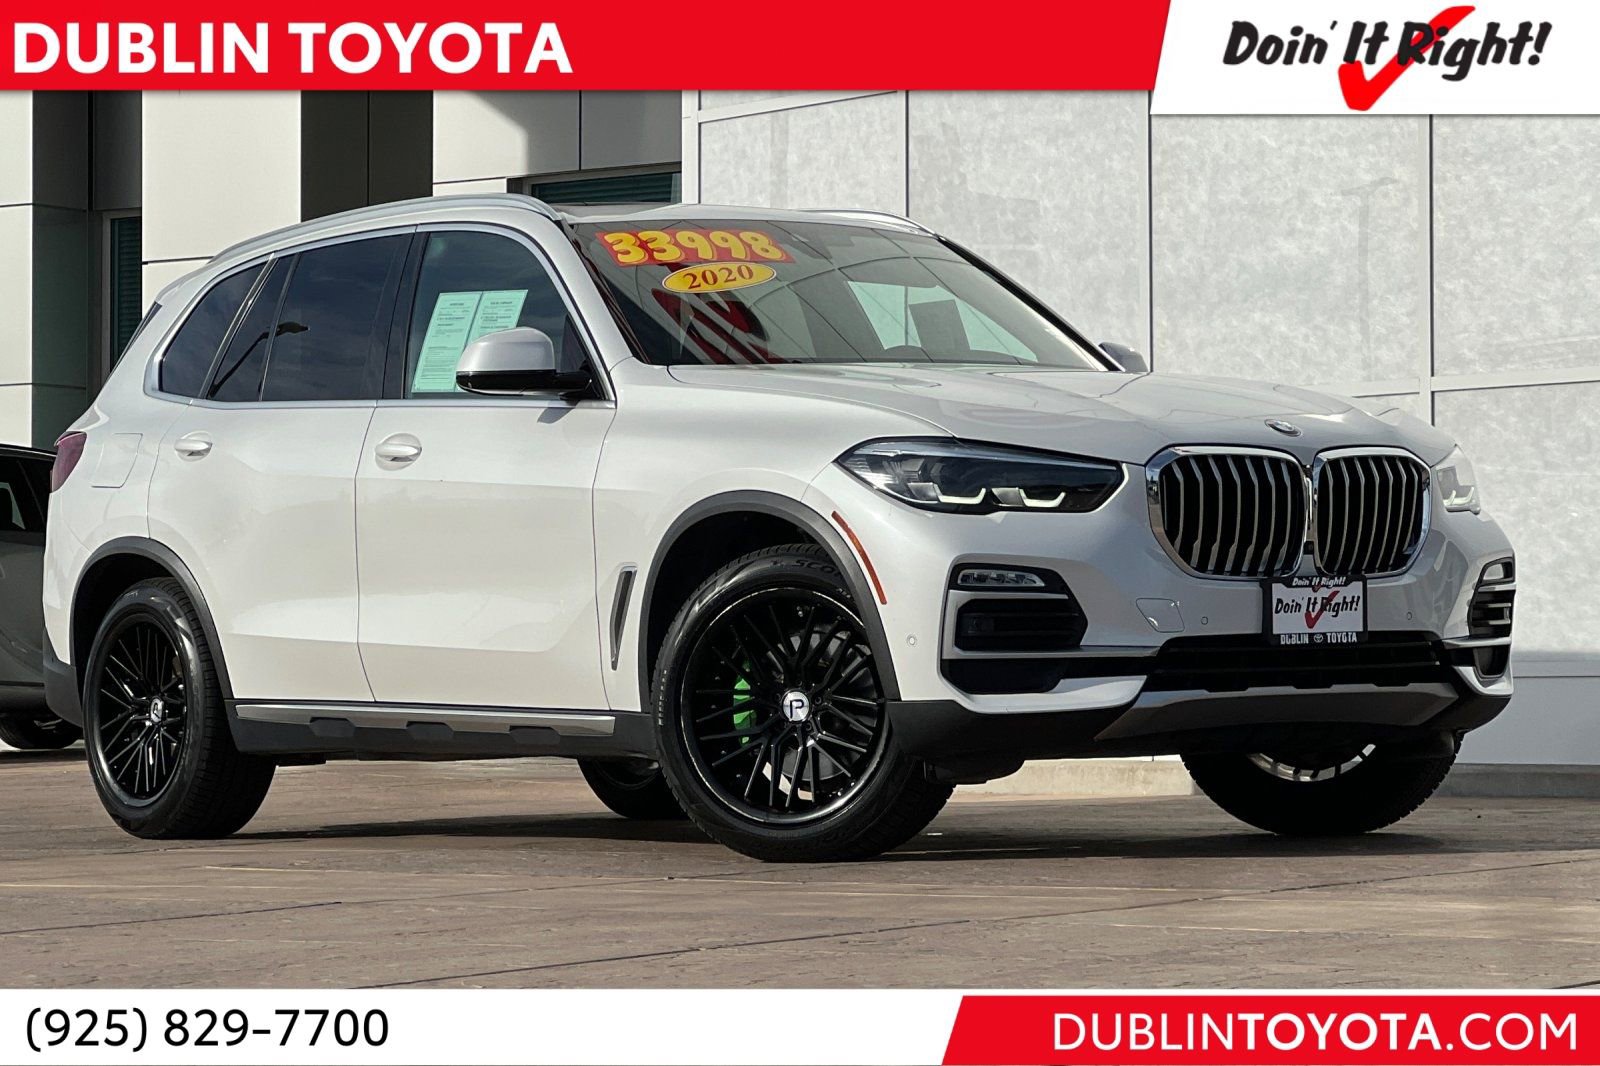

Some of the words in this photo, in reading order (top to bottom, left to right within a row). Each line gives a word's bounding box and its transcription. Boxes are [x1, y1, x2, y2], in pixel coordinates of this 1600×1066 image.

[603, 230, 786, 264] 33998
[683, 264, 755, 290] 2020
[1274, 597, 1304, 614] Doin'
[1306, 597, 1318, 612] It
[1280, 634, 1309, 645] DUBLIN
[1326, 632, 1358, 643] TOYOTA
